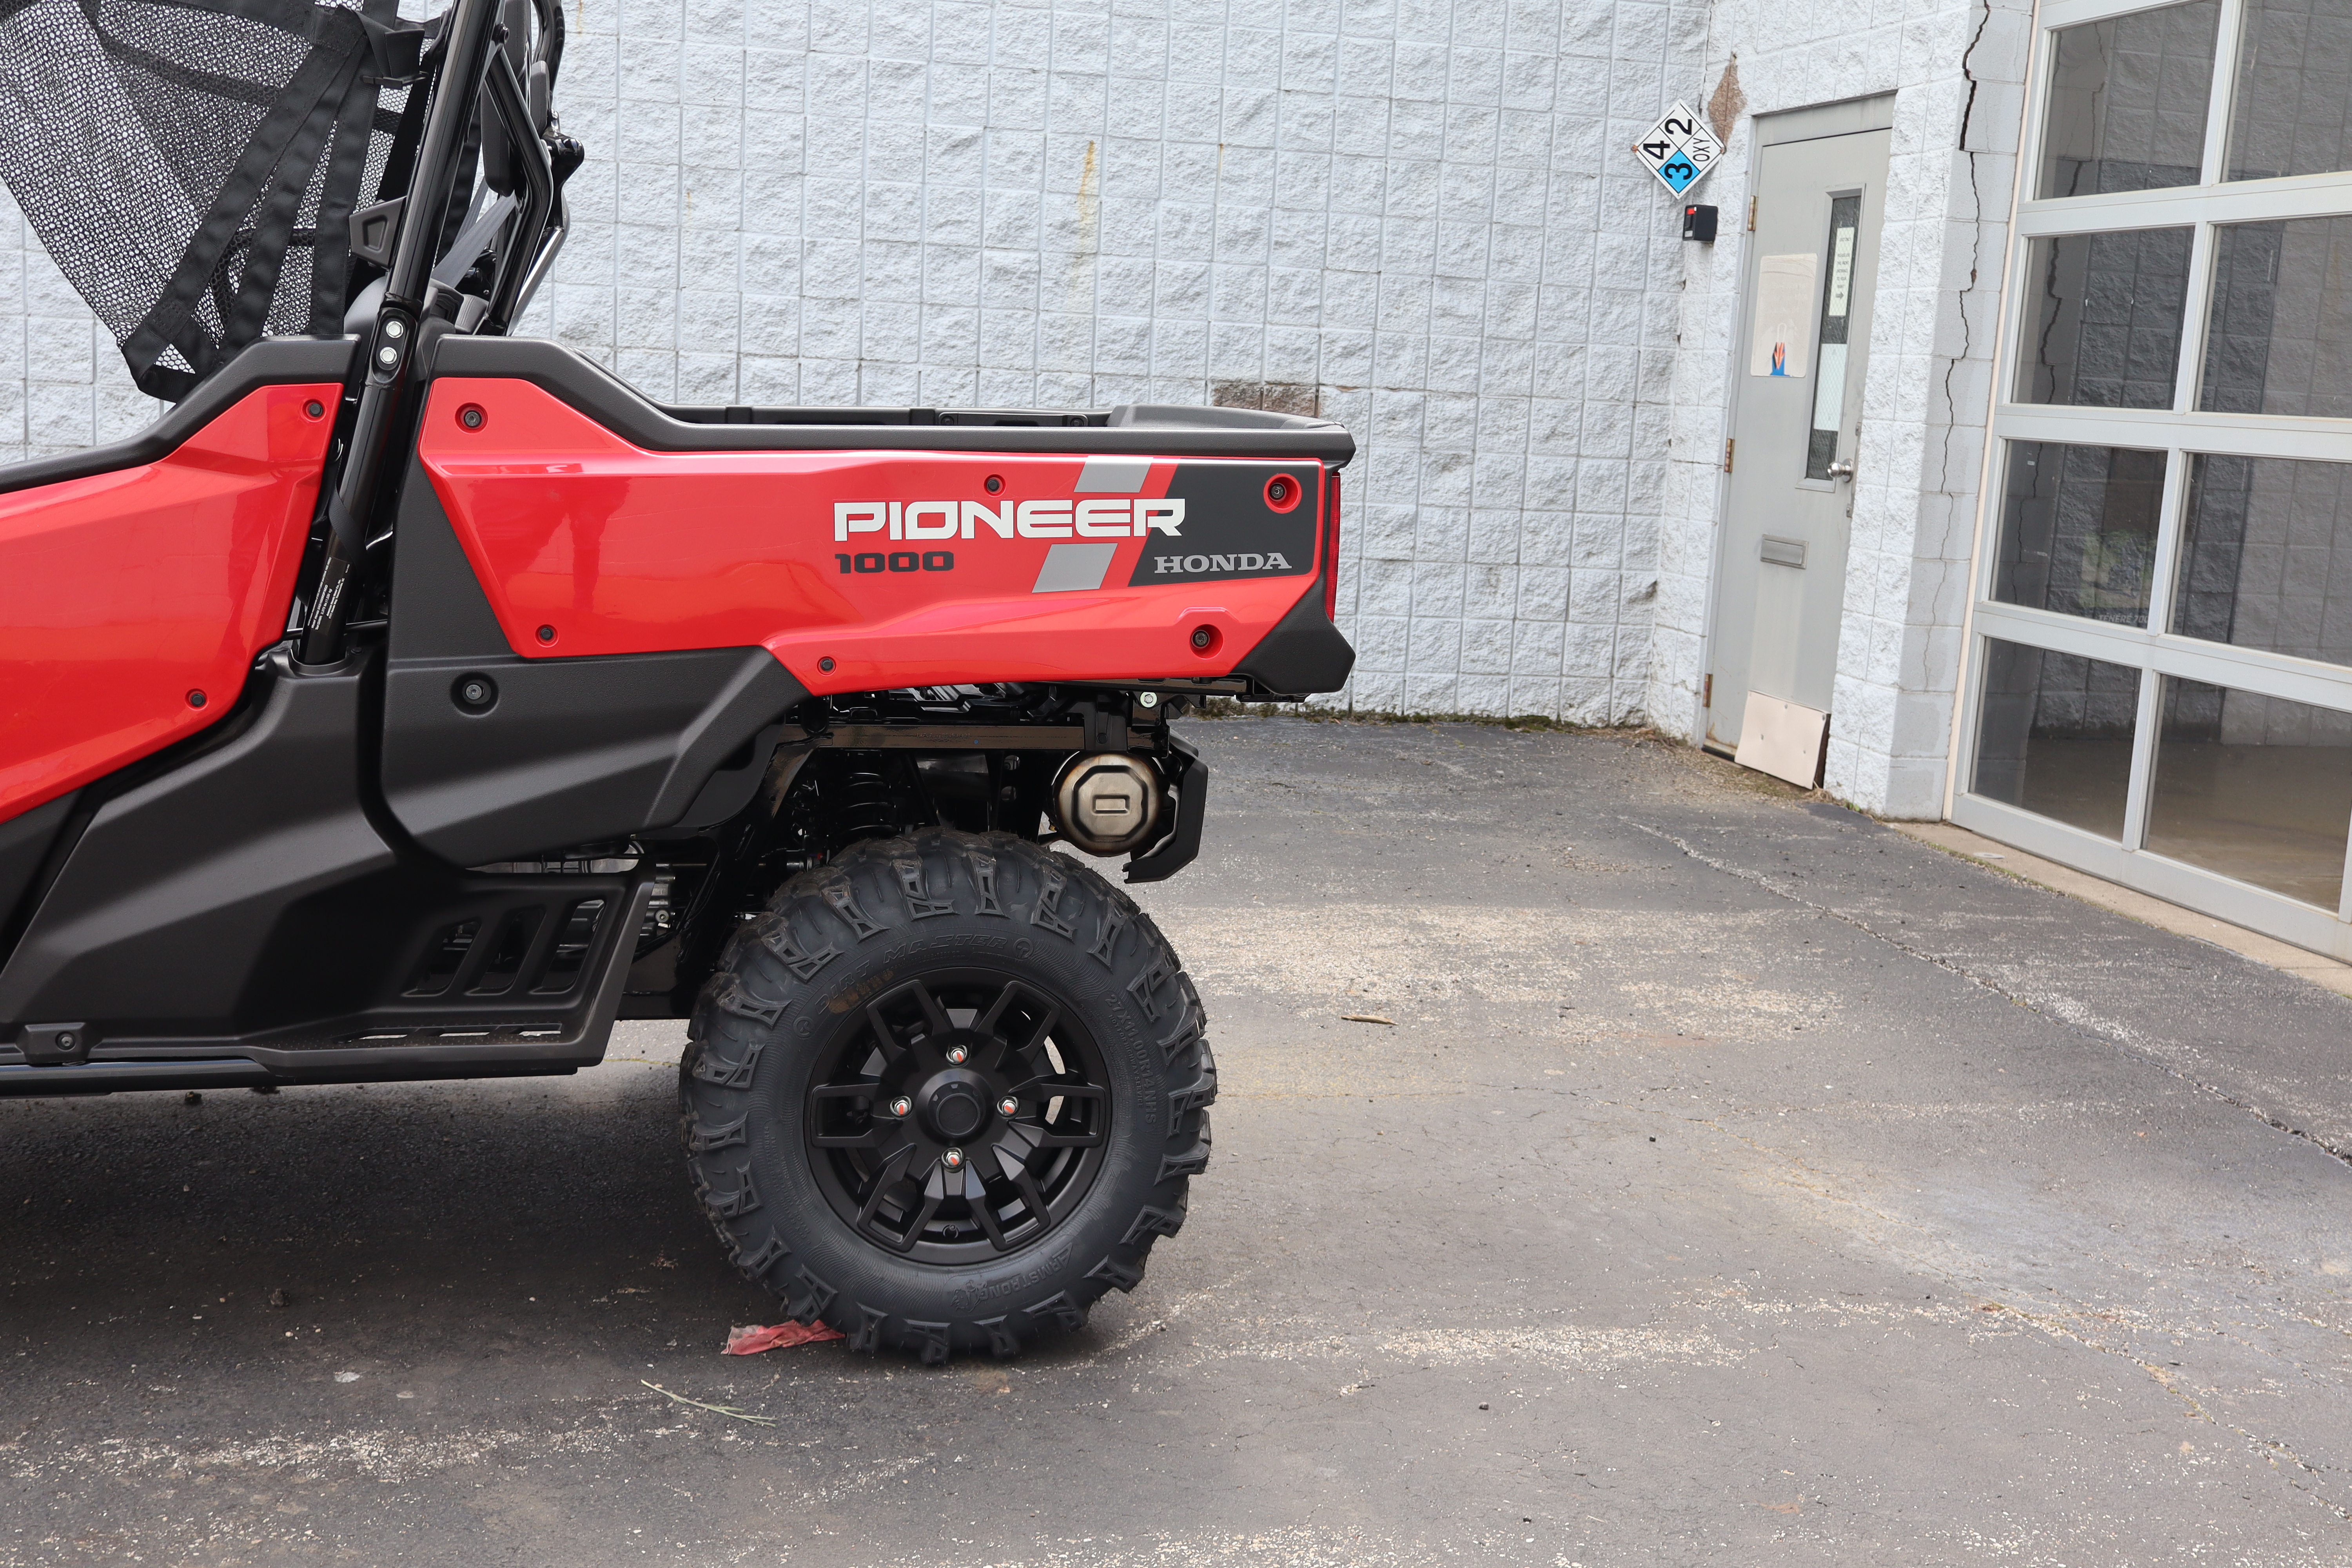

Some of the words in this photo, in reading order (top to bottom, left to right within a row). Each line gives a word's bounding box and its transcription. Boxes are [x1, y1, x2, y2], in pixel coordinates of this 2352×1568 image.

[1665, 118, 1692, 135] 2
[1643, 140, 1670, 160] 4
[1693, 138, 1710, 162] OXY
[1664, 163, 1693, 180] 3
[834, 499, 1185, 541] PIONEER
[835, 551, 954, 574] 1000
[1154, 553, 1292, 573] HONDA
[815, 960, 870, 1014] DIRT
[884, 935, 1008, 964] MASTER
[1108, 1014, 1120, 1028] NOT
[1116, 1028, 1127, 1043] FOR
[1124, 1042, 1139, 1075] HIGHWAY
[1134, 1076, 1143, 1107] SERVICE
[780, 1156, 790, 1180] CHINA
[979, 1243, 1073, 1300] ARMSTRONG
